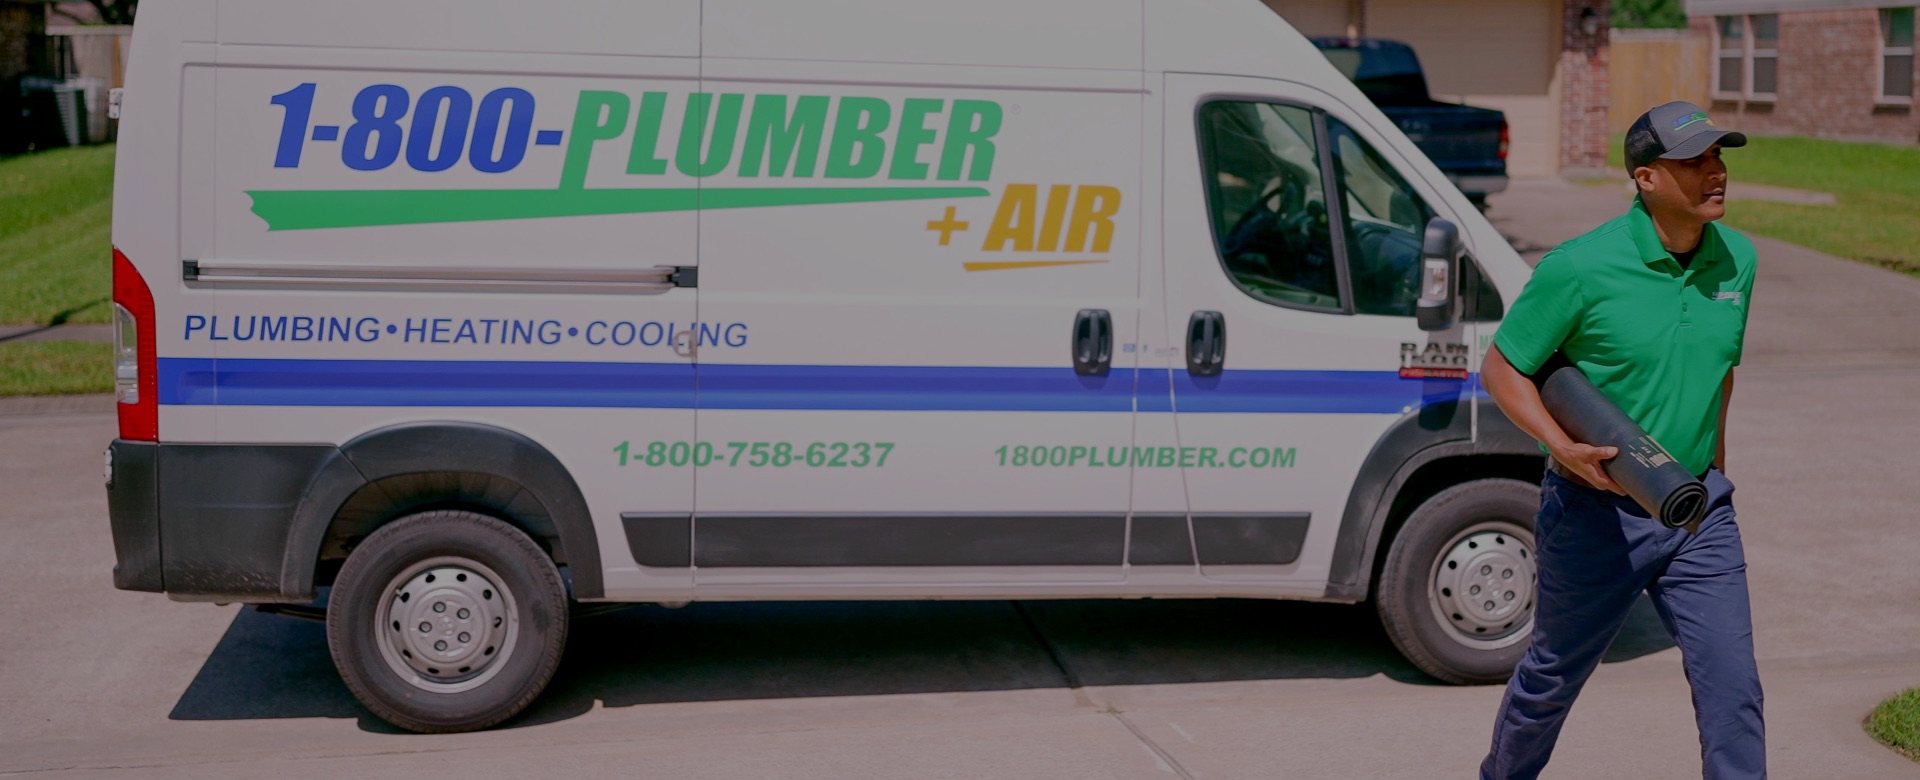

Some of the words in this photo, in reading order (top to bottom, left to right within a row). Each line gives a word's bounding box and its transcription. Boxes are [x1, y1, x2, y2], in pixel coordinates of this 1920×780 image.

[271, 83, 1004, 190] 1-800-PLUMBER
[982, 184, 1122, 253] AIR
[613, 440, 895, 468] 1-800-758-6237
[996, 445, 1297, 468] 1800PLUMBER.COM
